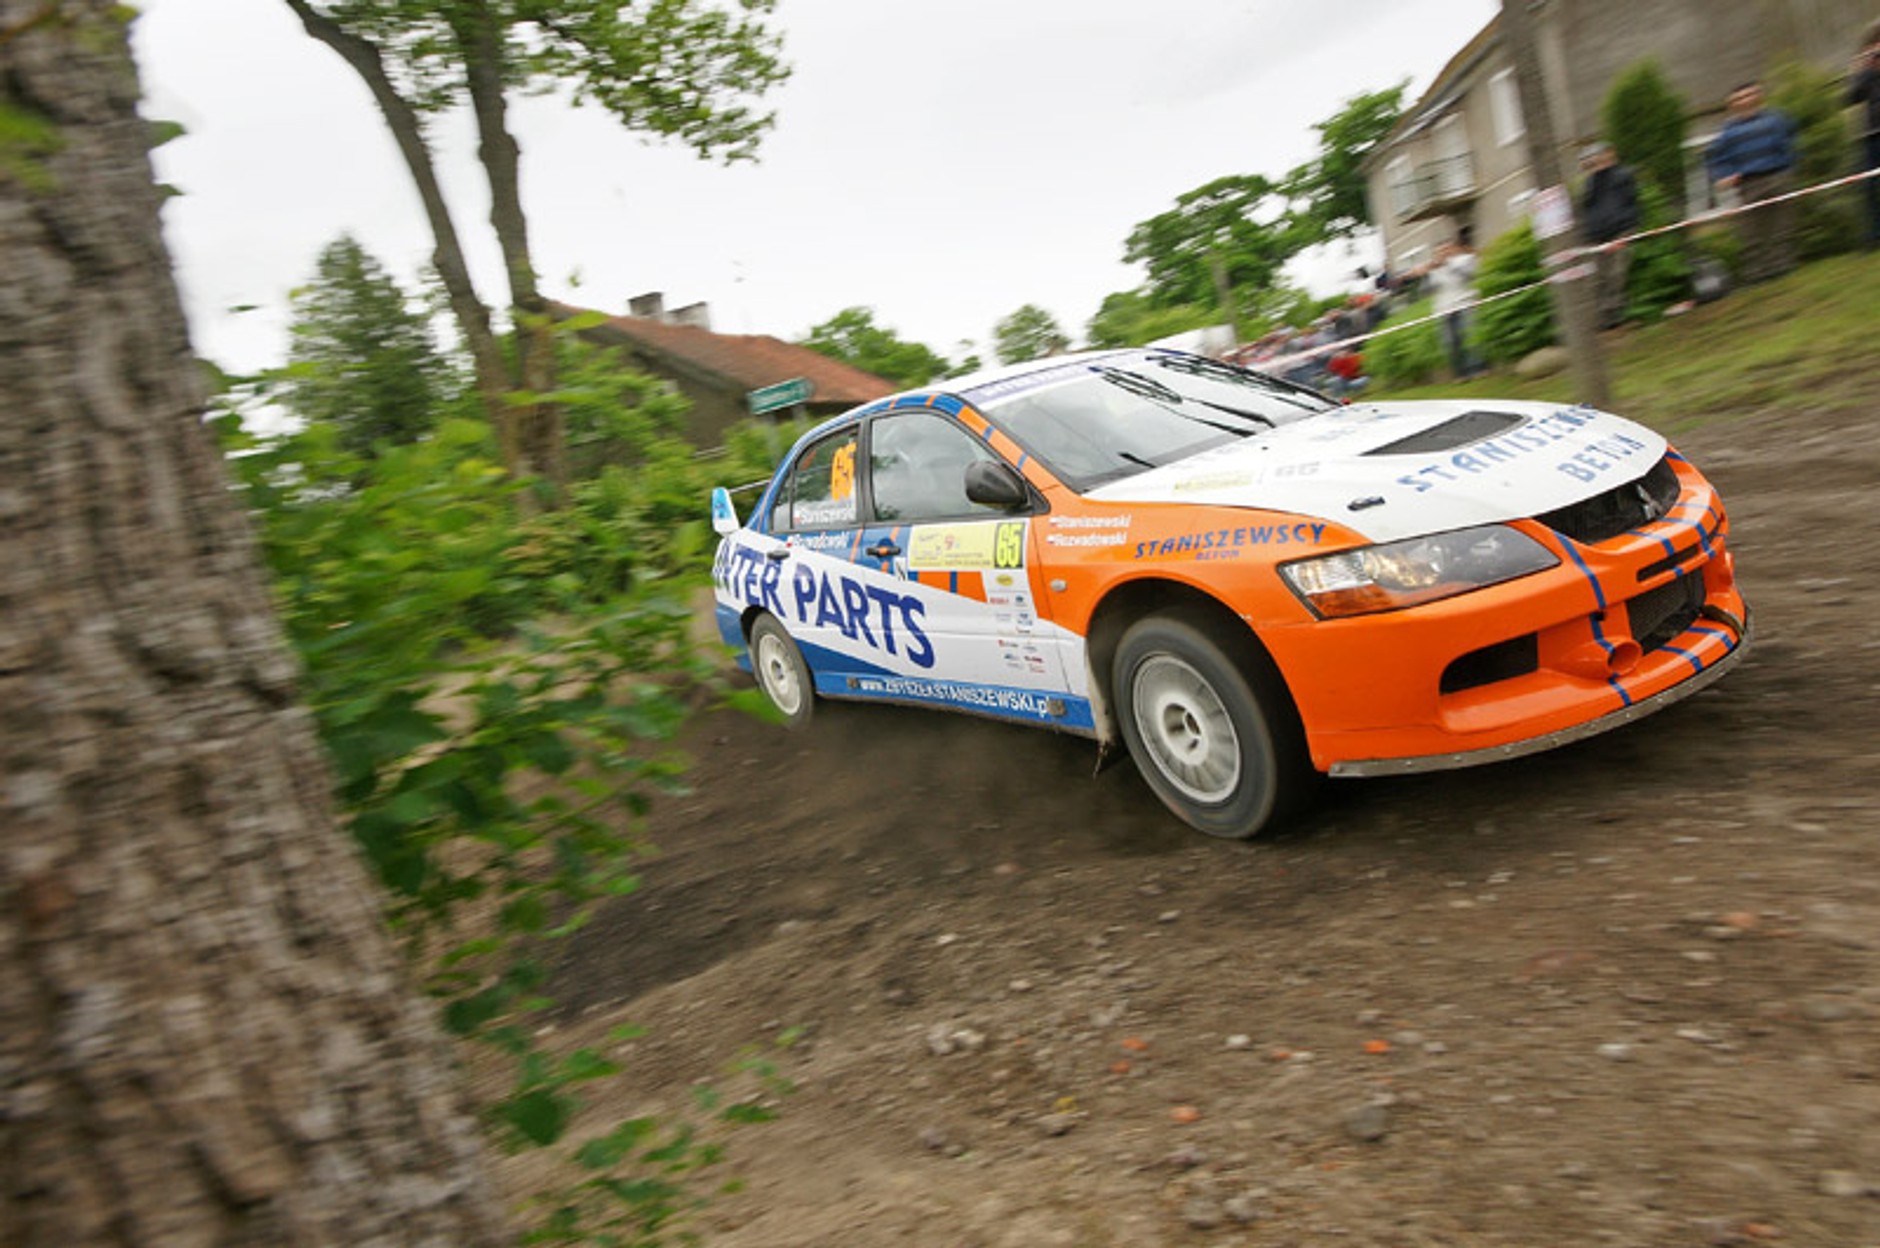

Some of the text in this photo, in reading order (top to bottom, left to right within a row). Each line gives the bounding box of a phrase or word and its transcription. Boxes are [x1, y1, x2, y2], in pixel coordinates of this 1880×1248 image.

[996, 522, 1023, 568] 65
[1134, 522, 1327, 559] STANISZEWSCY
[714, 537, 936, 669] NTER PARTS
